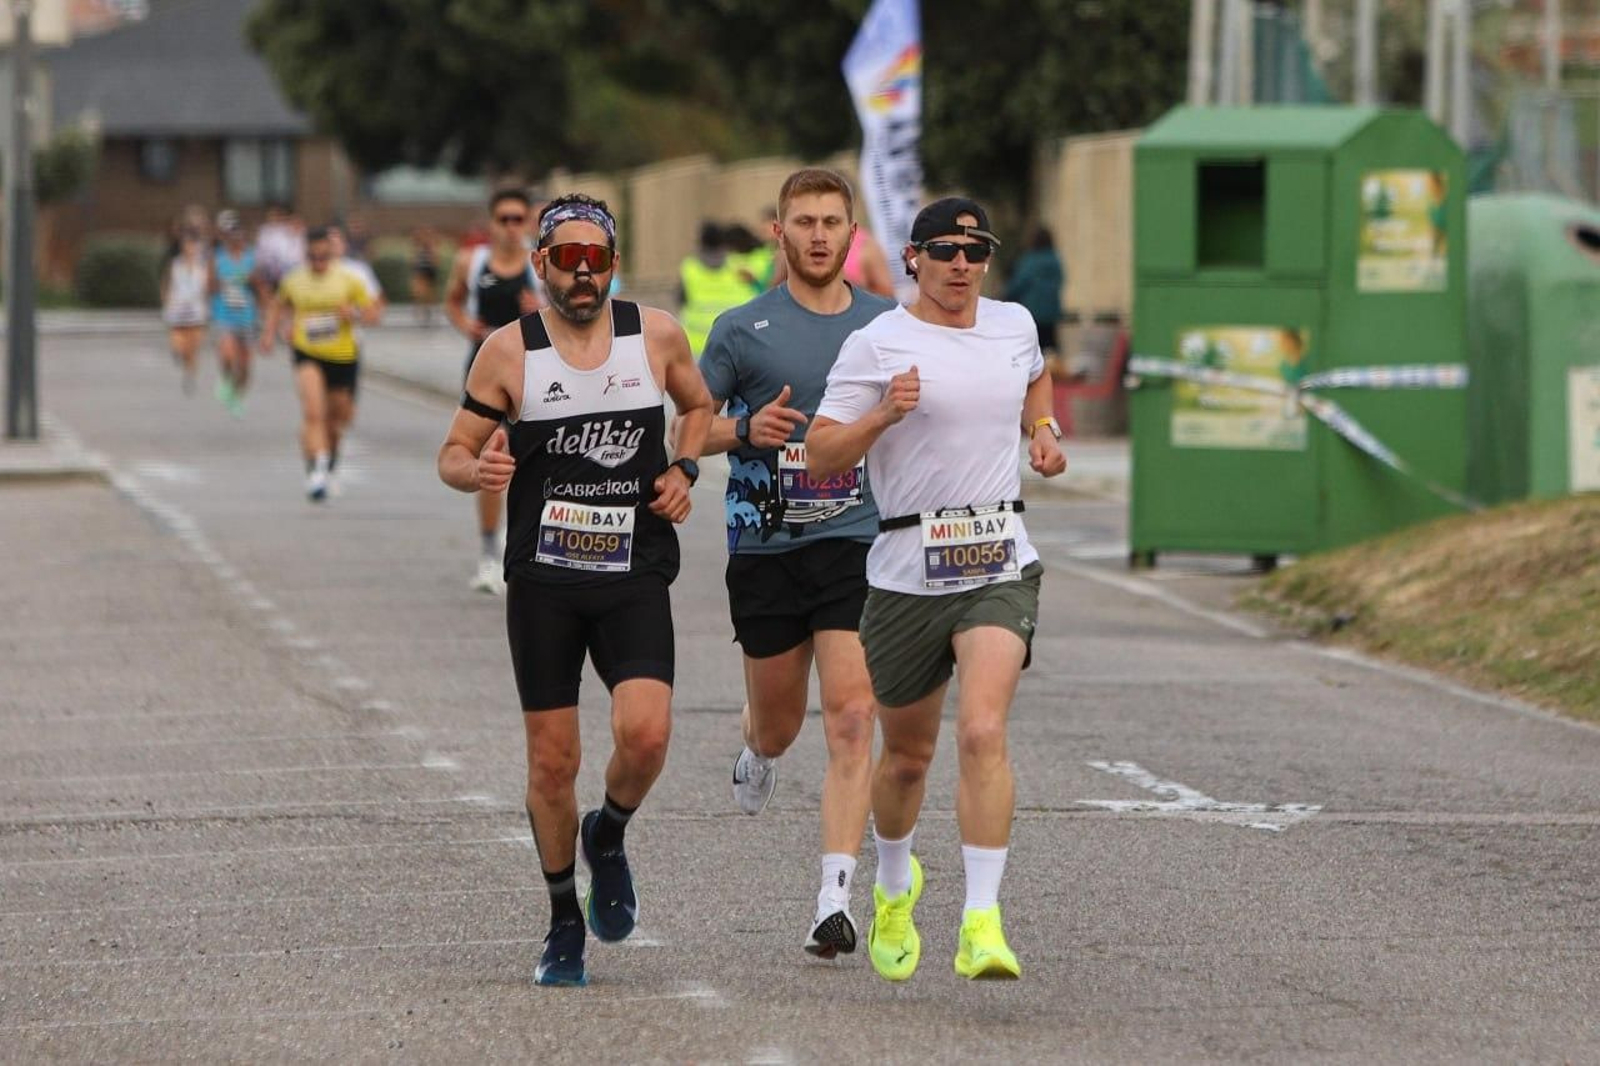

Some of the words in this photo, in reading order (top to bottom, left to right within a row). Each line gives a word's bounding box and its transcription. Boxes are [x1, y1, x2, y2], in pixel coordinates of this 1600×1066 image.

[546, 420, 645, 454] delikia
[549, 506, 627, 527] MINIBAY
[930, 518, 1006, 540] MINIBAY
[556, 529, 620, 553] 10059
